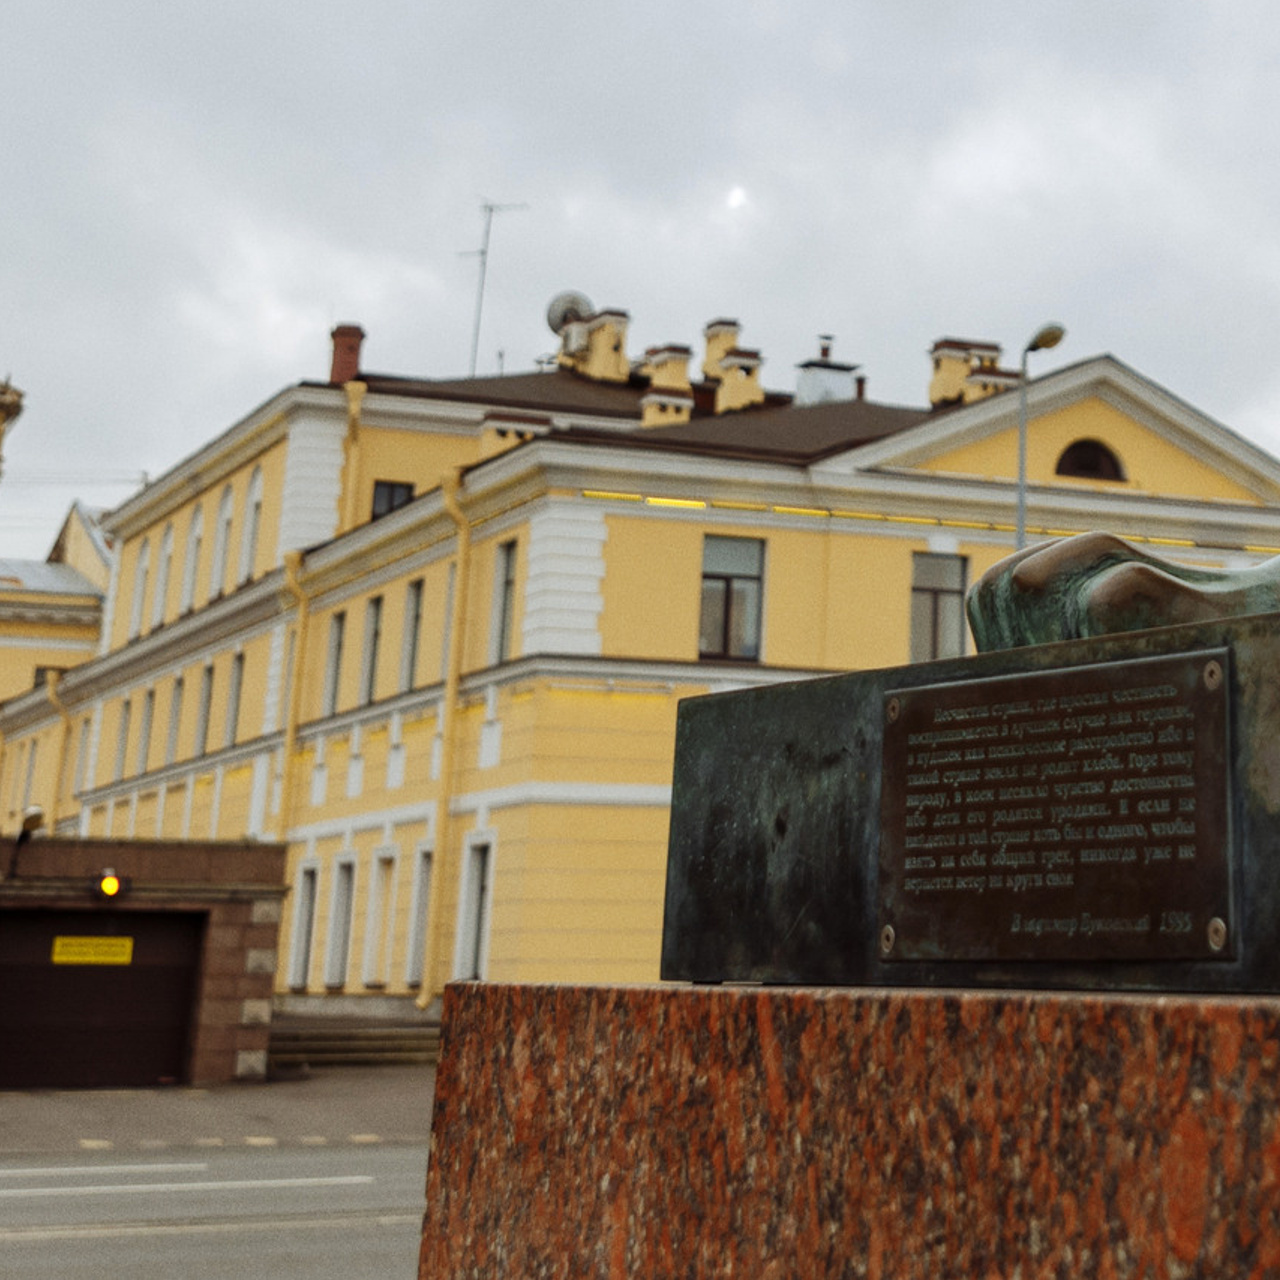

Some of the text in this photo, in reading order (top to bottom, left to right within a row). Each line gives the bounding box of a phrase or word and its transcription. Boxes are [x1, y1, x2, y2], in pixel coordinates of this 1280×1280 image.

[1022, 764, 1038, 778] не
[1129, 753, 1158, 773] Горе
[1161, 750, 1195, 769] тому
[954, 791, 962, 804] в
[965, 789, 994, 802] коем
[1053, 780, 1105, 800] чувство
[933, 812, 961, 828] дети
[967, 811, 986, 823] его
[992, 807, 1044, 827] родятся
[1119, 799, 1129, 814] И
[1137, 799, 1171, 814] если
[1178, 797, 1196, 811] не
[968, 829, 988, 844] той
[990, 830, 1030, 850] стране
[1063, 823, 1083, 840] бы
[1097, 824, 1147, 840] одного,
[1150, 816, 1196, 835] чтобы
[940, 855, 955, 868] на
[960, 849, 987, 867] себя
[991, 847, 1036, 868] общий
[1080, 847, 1137, 862] никогда
[1143, 846, 1173, 865] уже
[1178, 844, 1196, 859] не
[1006, 873, 1043, 892] круги
